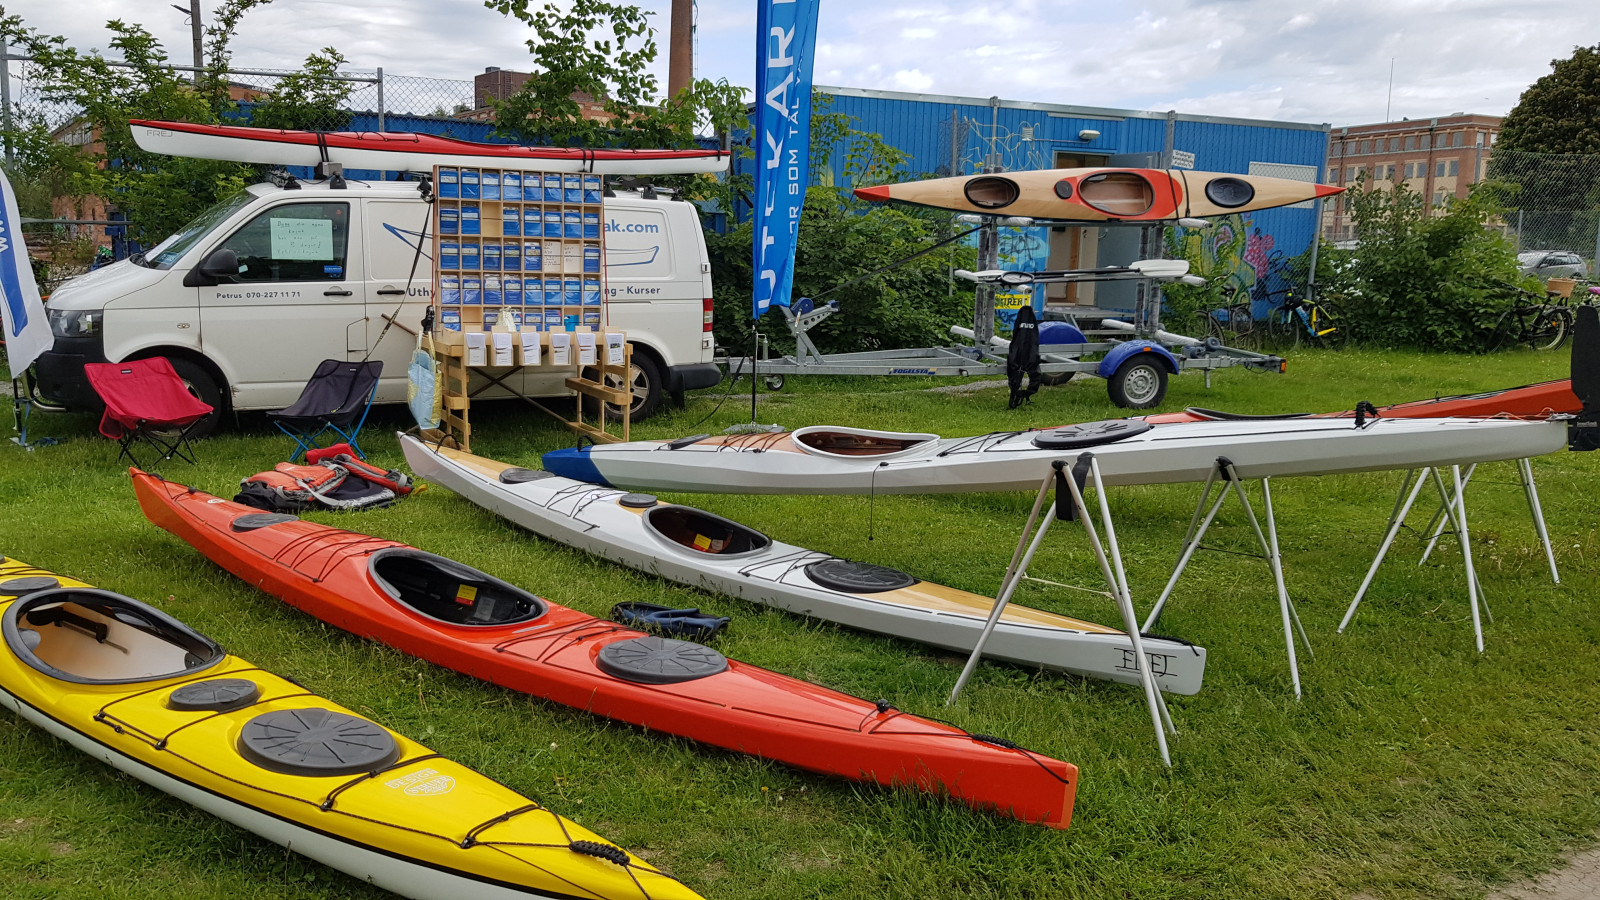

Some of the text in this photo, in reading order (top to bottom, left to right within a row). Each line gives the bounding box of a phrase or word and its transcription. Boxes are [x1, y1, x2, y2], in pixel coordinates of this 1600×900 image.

[788, 97, 800, 139] TÅL
[146, 129, 173, 137] FREJ
[758, 0, 797, 308] UTEKAR
[788, 149, 799, 195] SOM
[603, 218, 659, 233] ak.com
[246, 291, 278, 299] 070-227
[408, 287, 436, 299] Uthy
[603, 287, 617, 297] ng
[626, 286, 661, 295] Kurser
[384, 768, 439, 789] DESIGN
